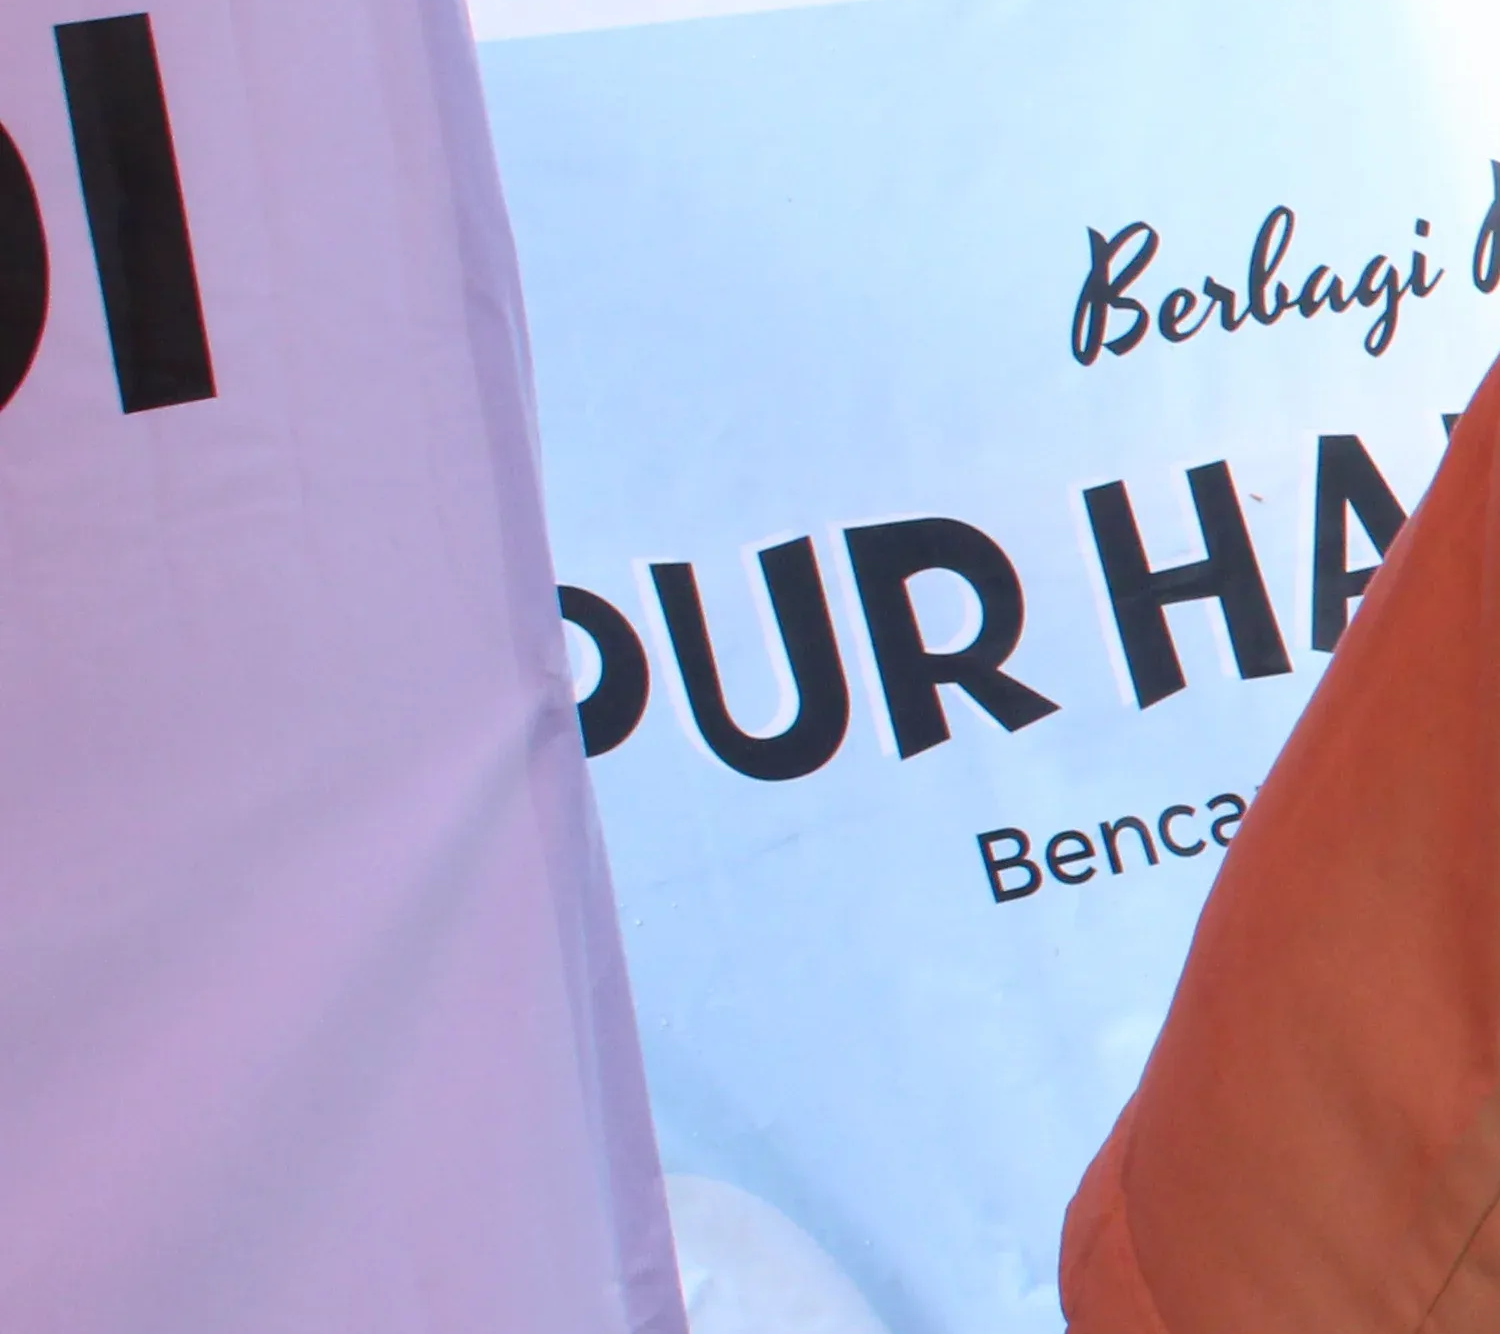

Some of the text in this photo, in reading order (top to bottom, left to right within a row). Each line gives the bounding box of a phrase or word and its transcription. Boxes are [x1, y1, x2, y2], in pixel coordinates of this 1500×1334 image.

[1071, 204, 1445, 367] Berbagi
[1082, 412, 1463, 711] HA
[976, 784, 1262, 903] Benca
